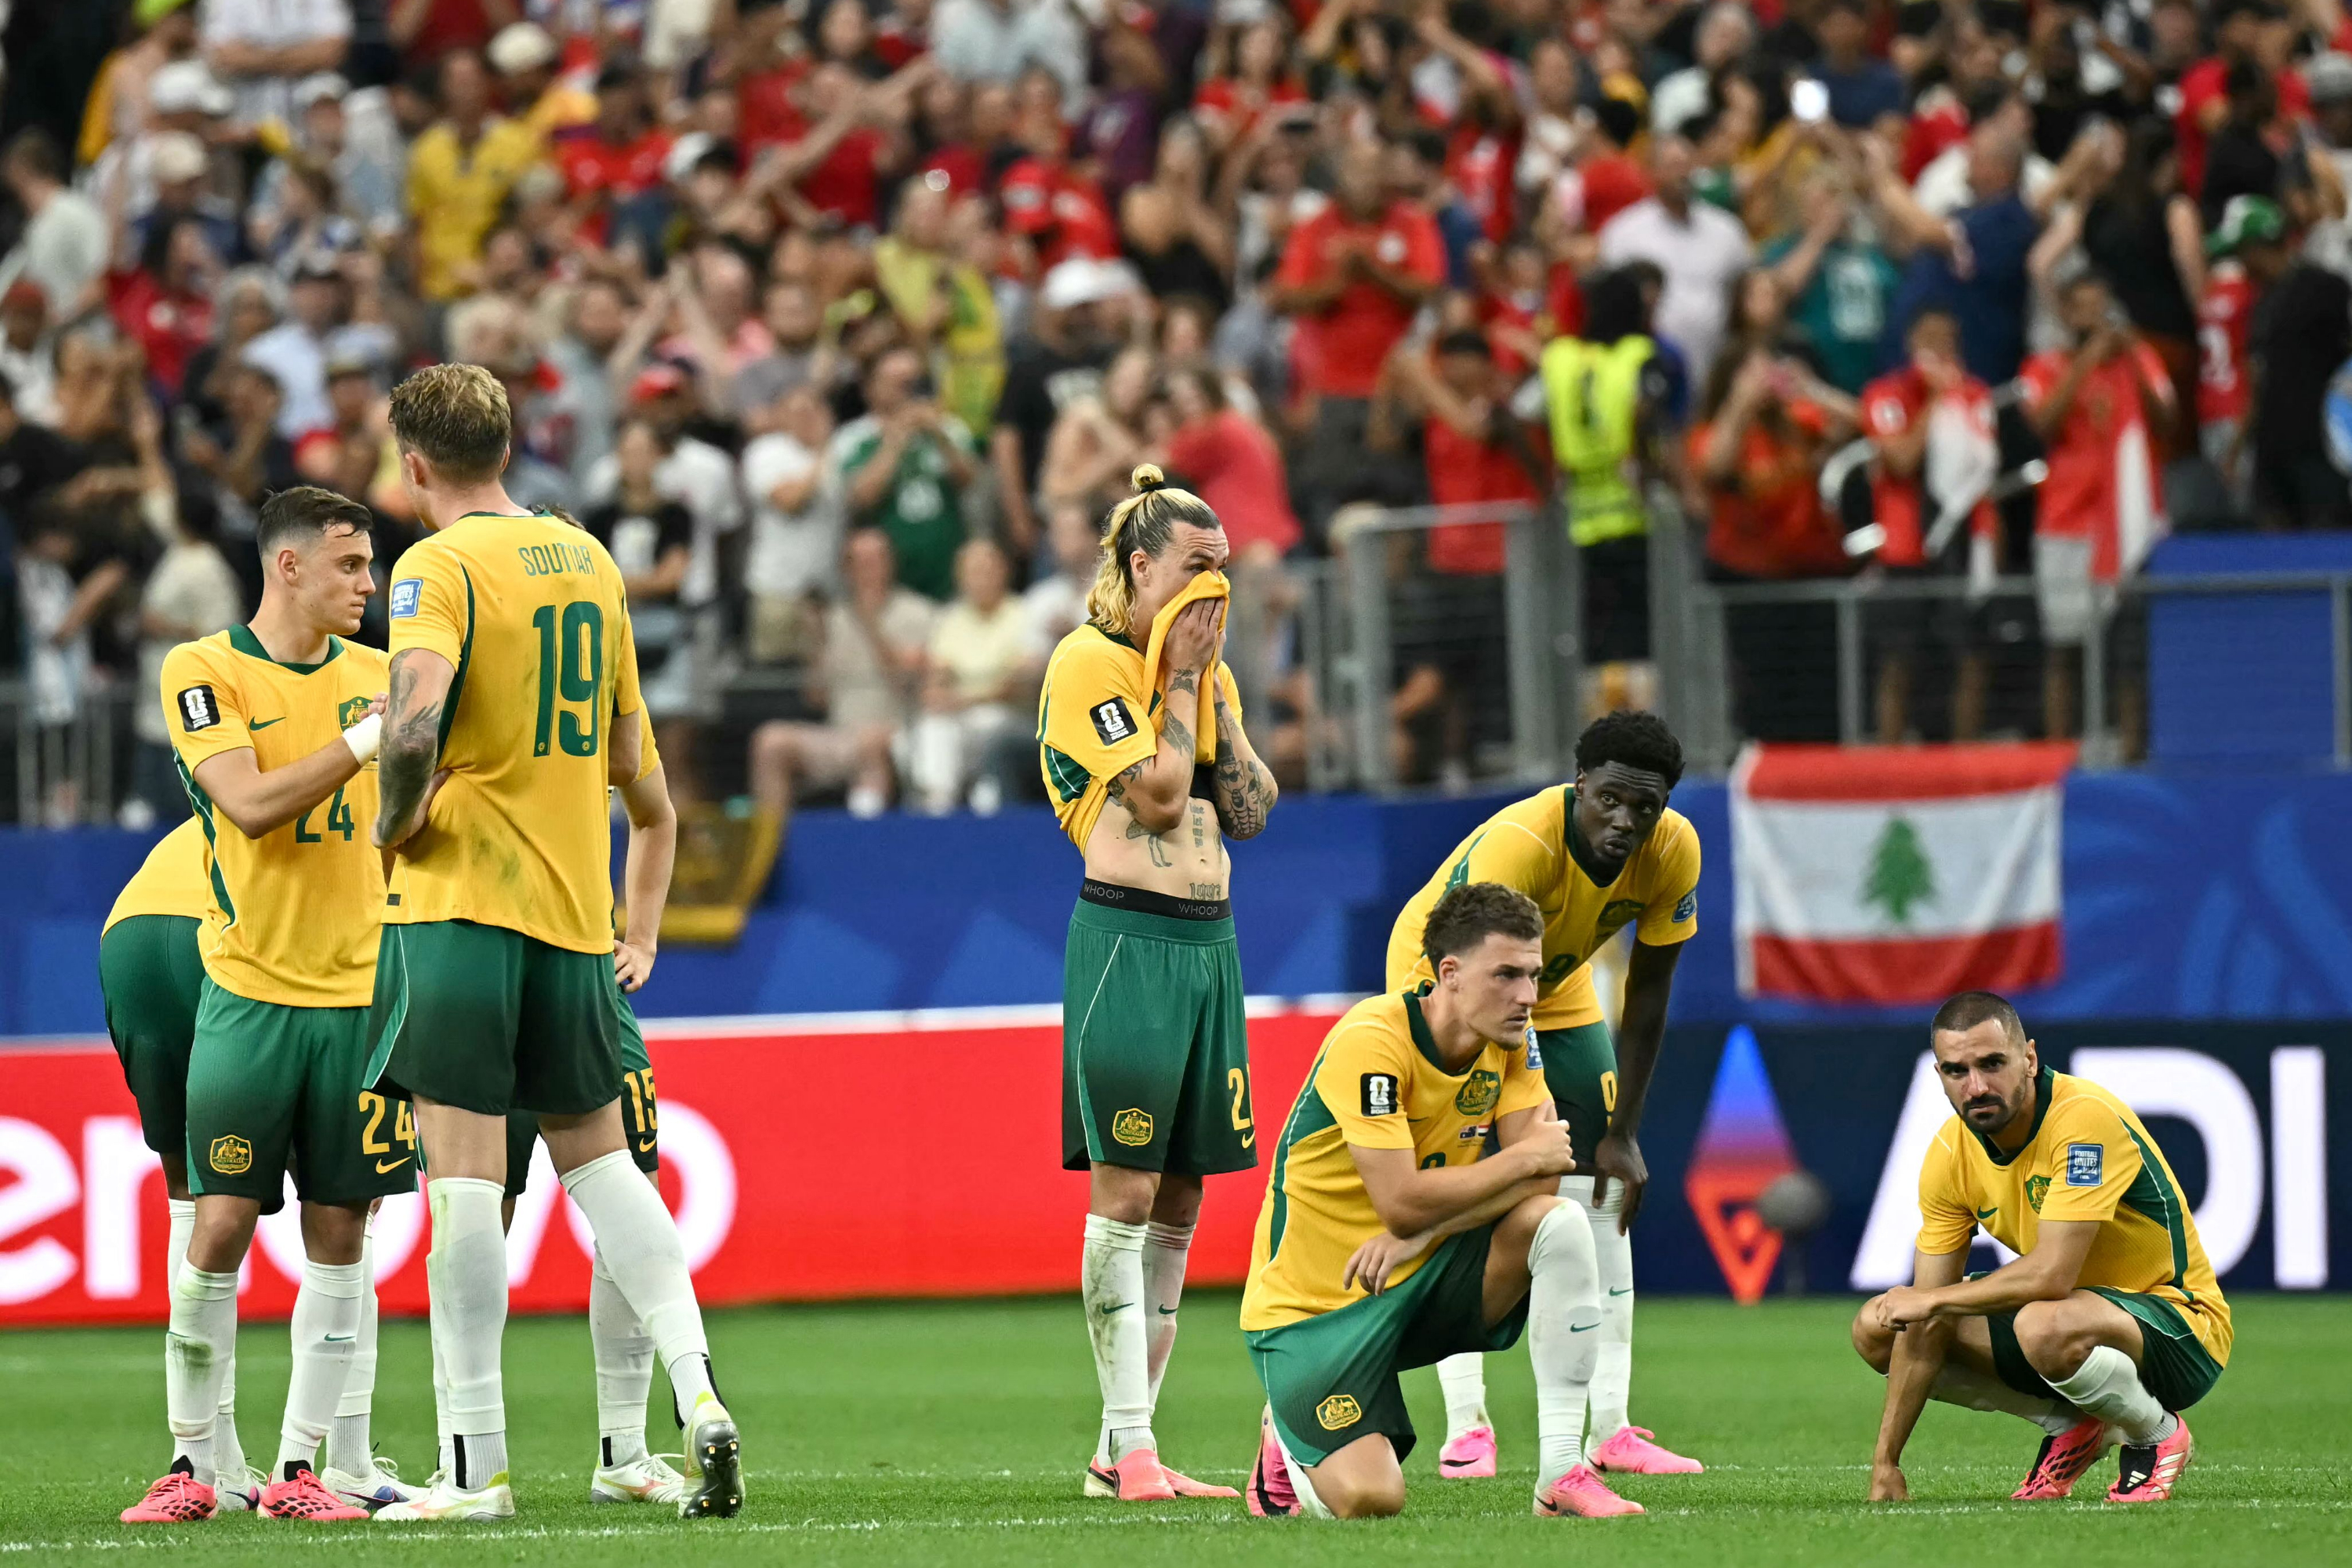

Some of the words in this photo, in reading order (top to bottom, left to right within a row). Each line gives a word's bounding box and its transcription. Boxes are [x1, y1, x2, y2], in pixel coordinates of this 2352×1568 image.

[533, 601, 603, 757] 19
[1084, 883, 1124, 900] WHOOP
[1178, 903, 1218, 916] WHOOP
[358, 1091, 415, 1155] 24
[624, 1067, 657, 1132] 15
[1228, 1063, 1254, 1131] 2
[2074, 1157, 2098, 1167] UNITES
